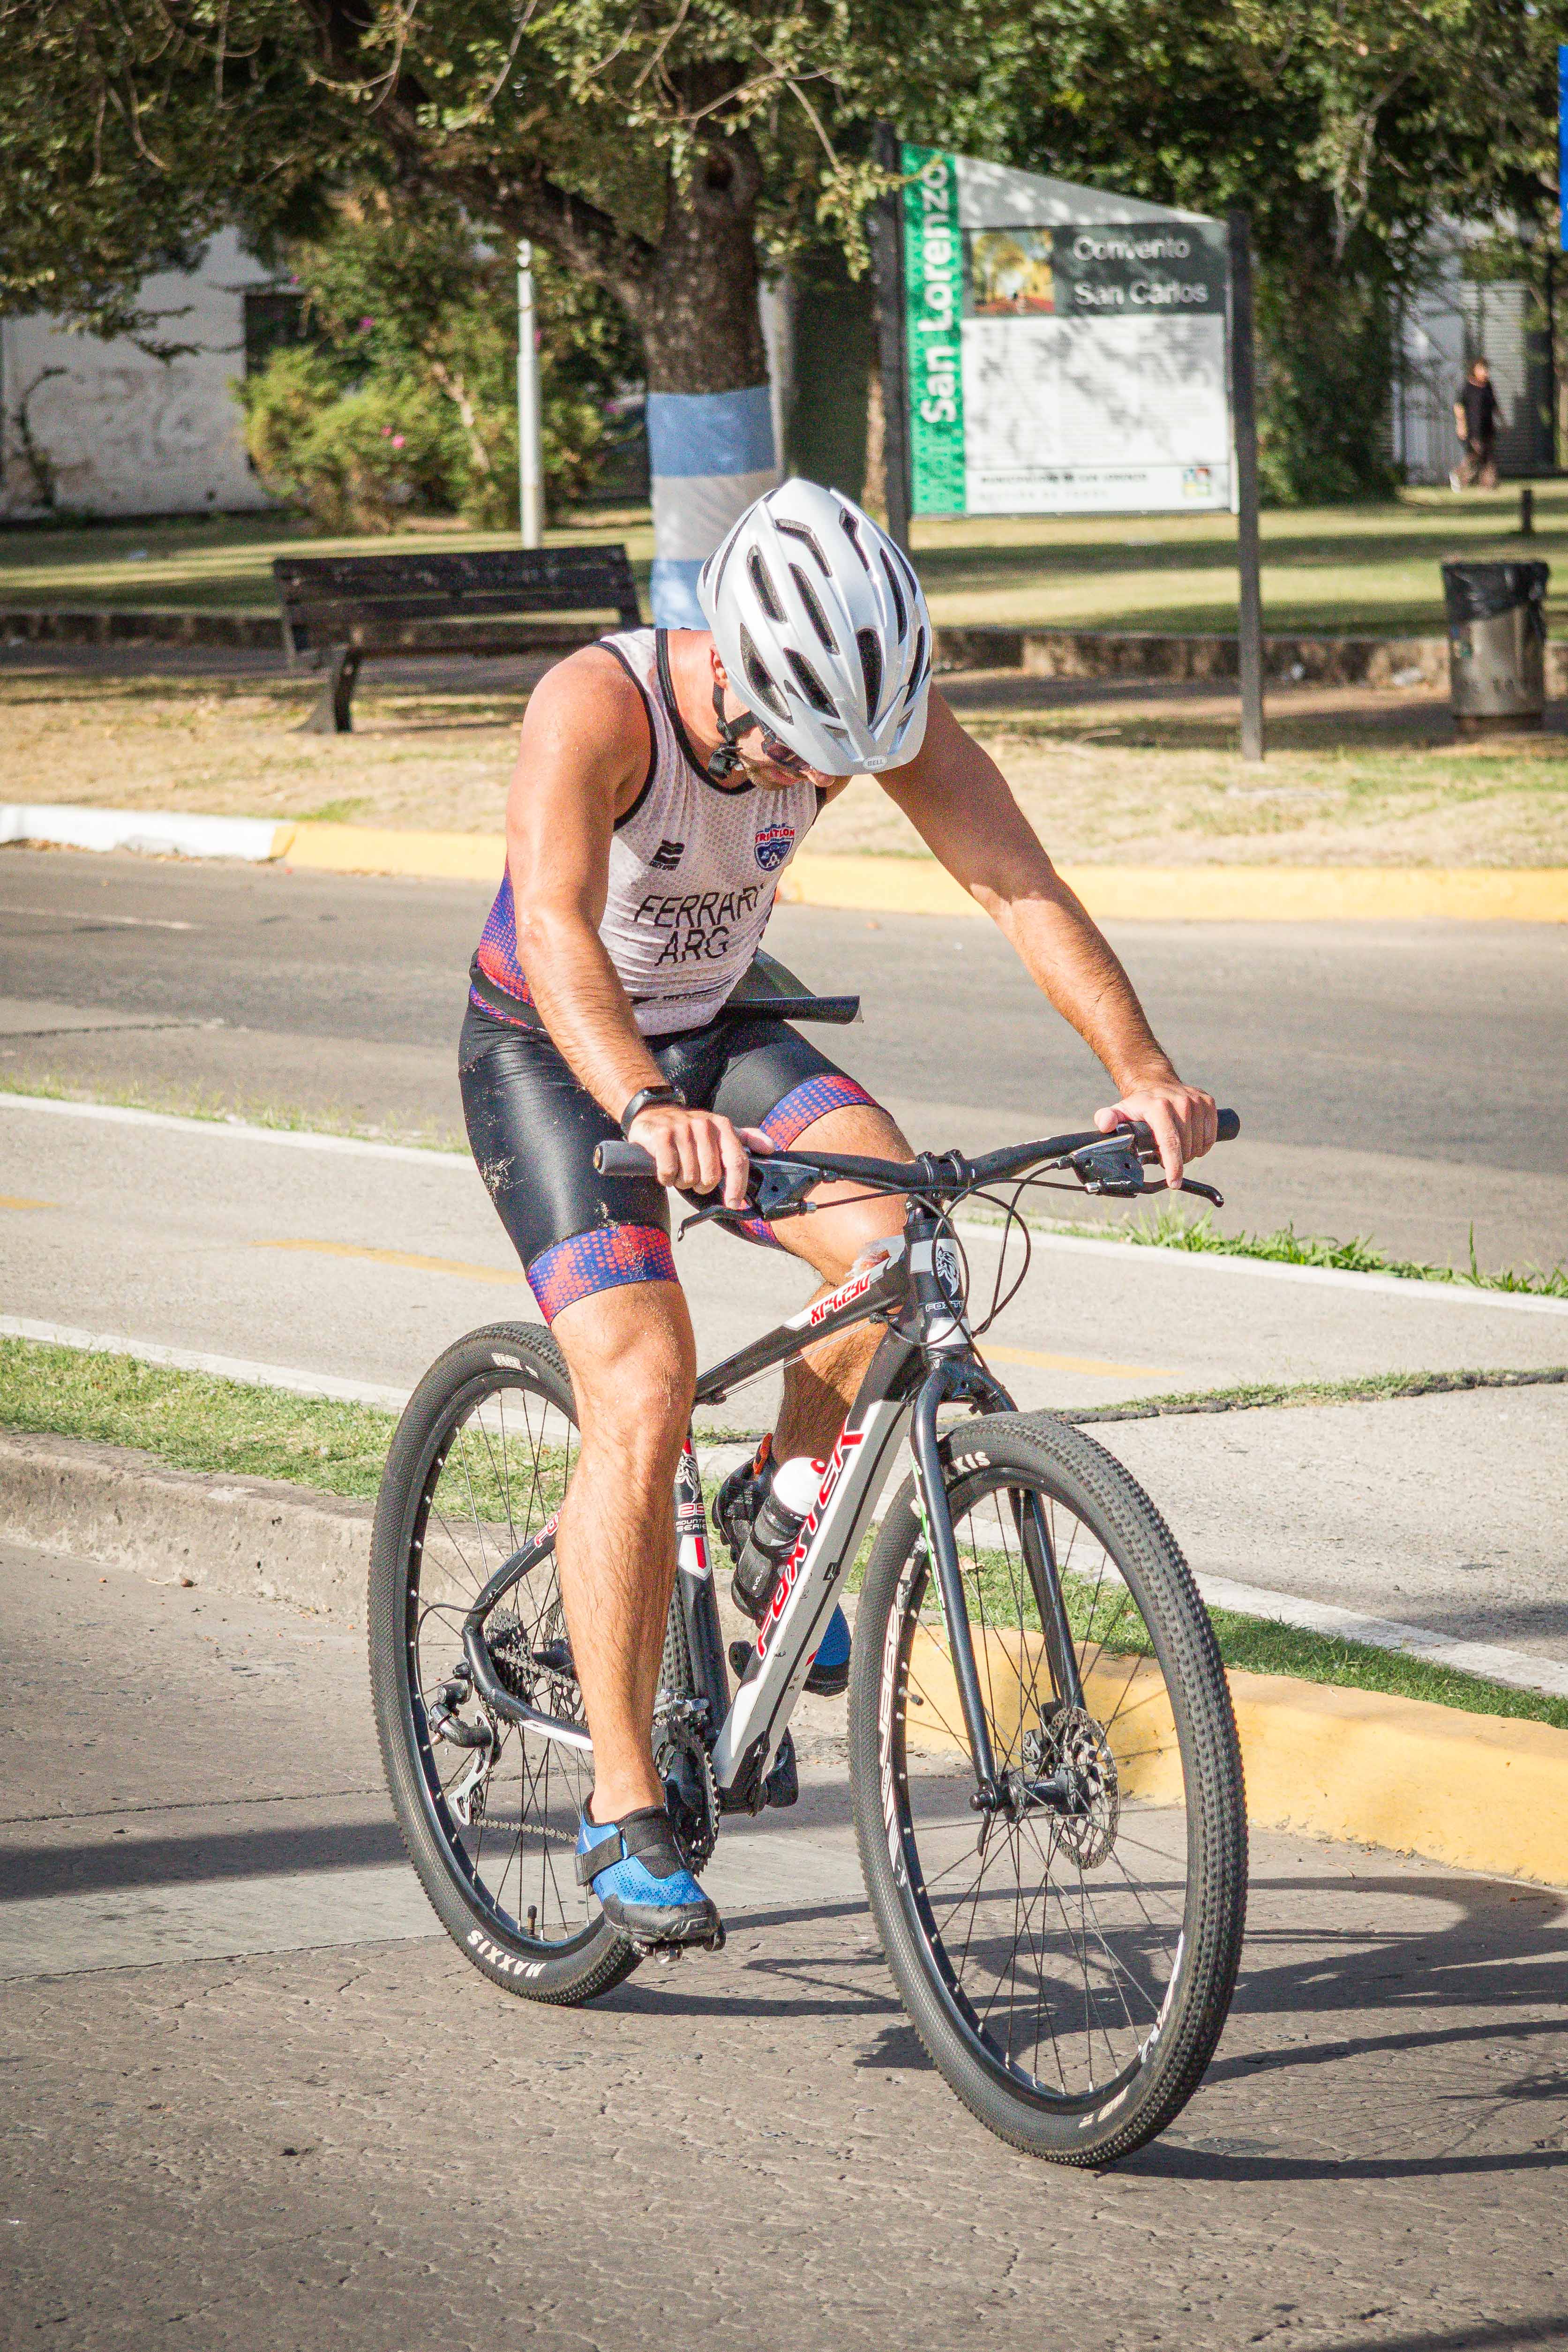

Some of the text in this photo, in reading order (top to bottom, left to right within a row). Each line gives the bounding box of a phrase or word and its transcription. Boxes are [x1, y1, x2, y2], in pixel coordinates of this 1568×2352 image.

[1074, 235, 1191, 261] Convento
[918, 162, 956, 423] San Lorenzo
[1074, 280, 1208, 305] San Carlos
[654, 925, 730, 966] ARG
[467, 1930, 548, 1977] MAXXIS
